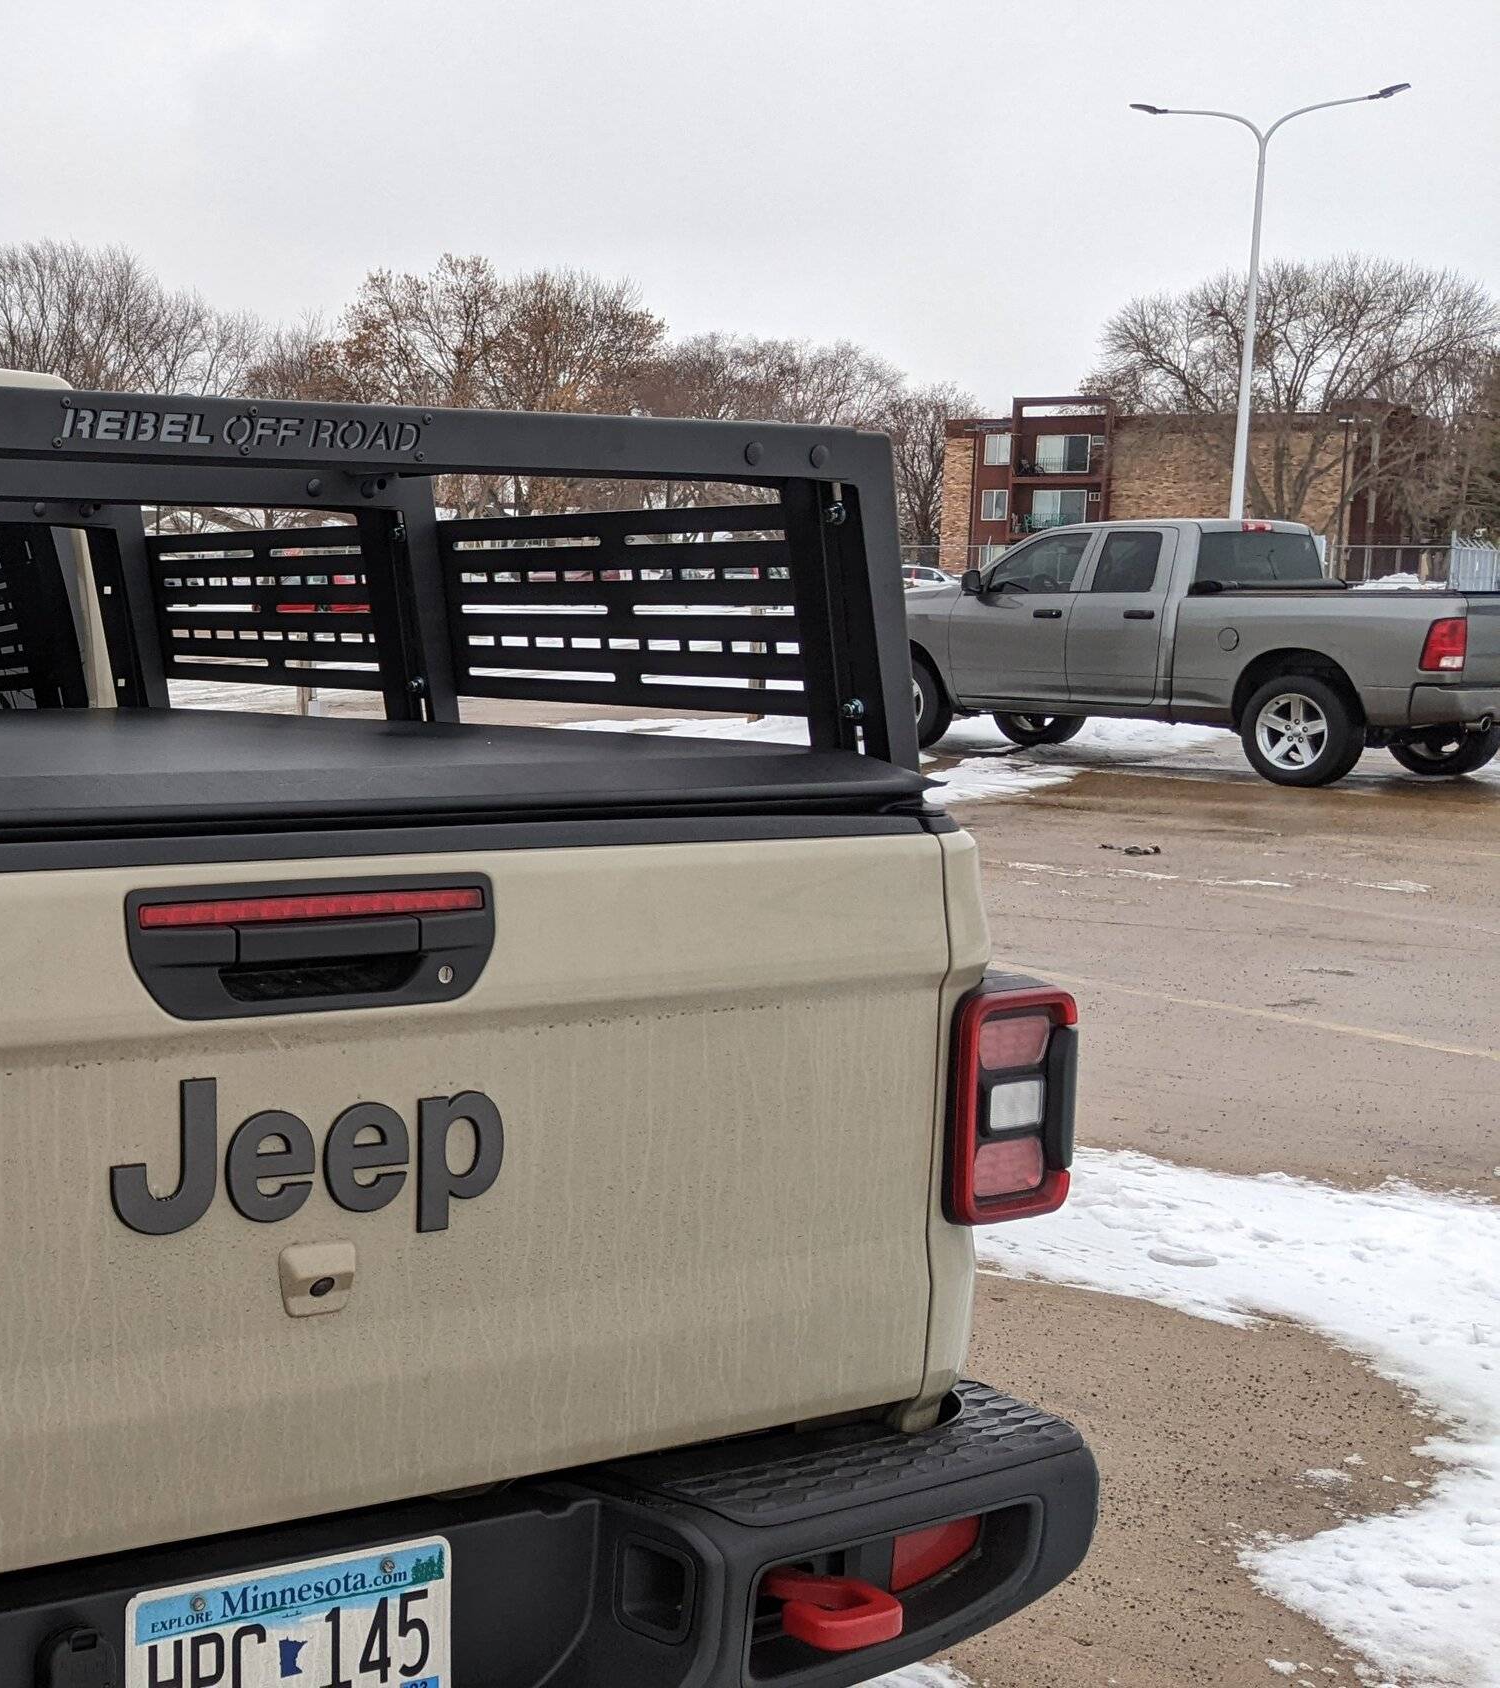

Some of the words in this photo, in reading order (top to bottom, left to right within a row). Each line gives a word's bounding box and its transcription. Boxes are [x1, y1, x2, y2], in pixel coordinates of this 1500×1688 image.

[62, 408, 214, 444] REBEL
[222, 414, 304, 448] OFF
[308, 417, 422, 452] ROAD
[109, 1077, 505, 1235] Jeep
[151, 1610, 213, 1634] EXPLORE
[219, 1569, 408, 1619] Minnesota.com
[320, 1589, 429, 1688] 145
